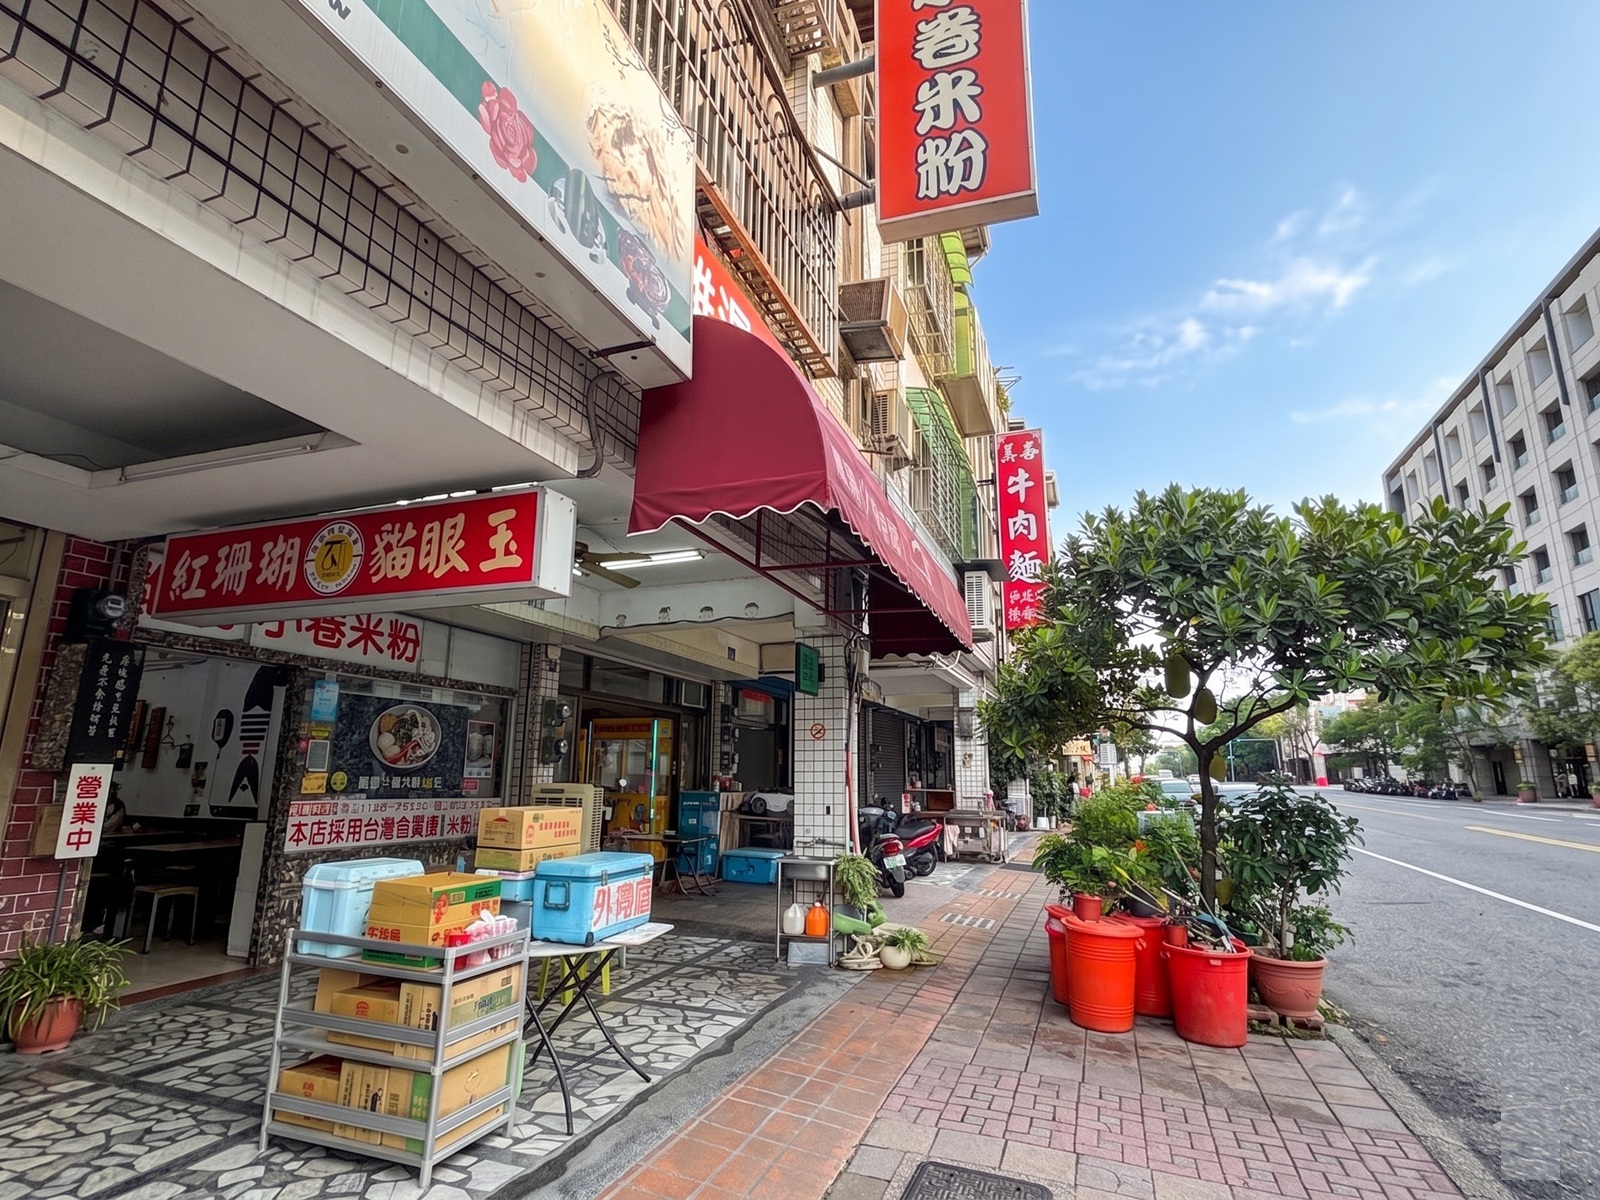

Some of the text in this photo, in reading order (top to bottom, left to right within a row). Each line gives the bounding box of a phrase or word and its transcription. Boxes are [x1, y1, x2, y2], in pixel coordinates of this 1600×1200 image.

[912, 0, 989, 201] 卷米粉
[169, 533, 301, 602] 紅珊瑚
[368, 508, 523, 583] 貓眼玉
[66, 774, 103, 852] 營業中
